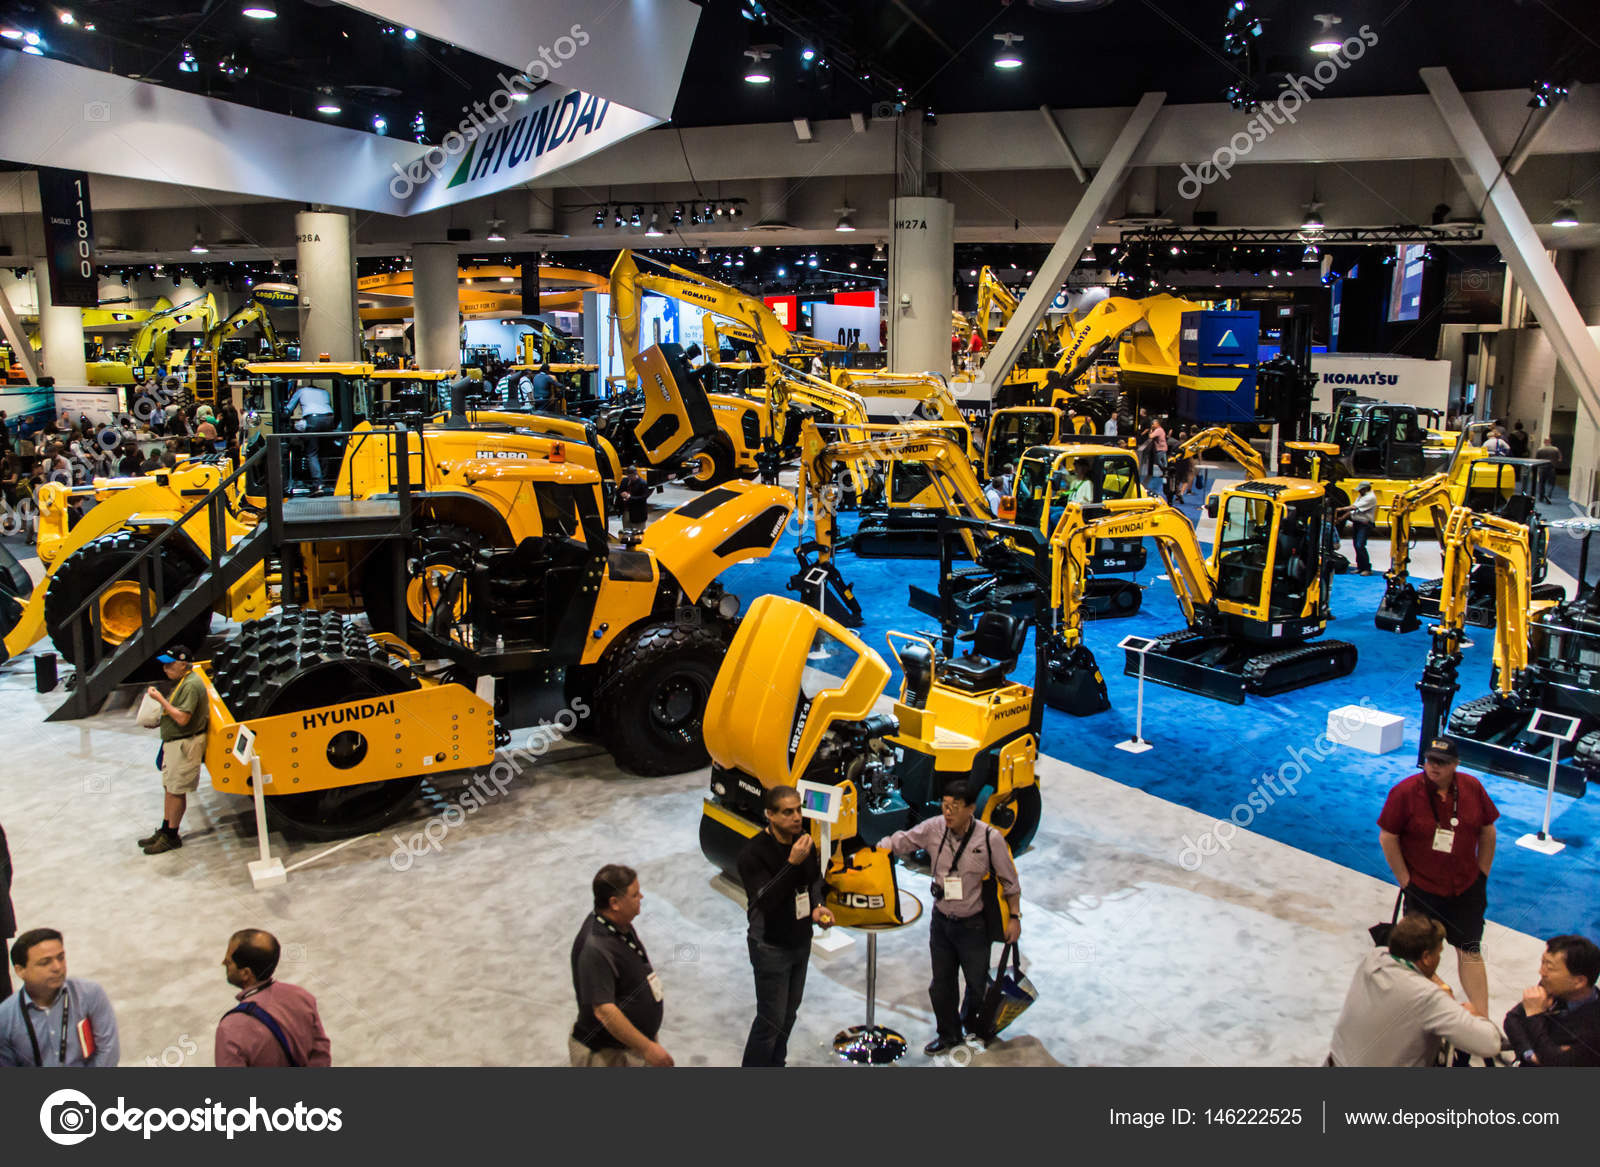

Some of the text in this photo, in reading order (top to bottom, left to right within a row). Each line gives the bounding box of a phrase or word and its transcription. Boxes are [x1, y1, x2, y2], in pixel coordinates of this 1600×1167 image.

[470, 89, 611, 182] HYUNDAI
[682, 289, 717, 304] KOMATSU
[1065, 325, 1091, 361] KOMATSU
[1323, 371, 1399, 386] KOMATSU
[877, 388, 906, 396] HYUNDAI
[960, 408, 987, 418] NDAI
[886, 444, 928, 455] HYUNDAI
[1108, 522, 1144, 536] HYUNDAI
[302, 699, 395, 730] HYUNDAI
[994, 703, 1030, 721] HYUNDAI
[789, 702, 811, 753] HR26T-9
[738, 779, 761, 797] HYUNDAI
[841, 893, 885, 908] JCB
